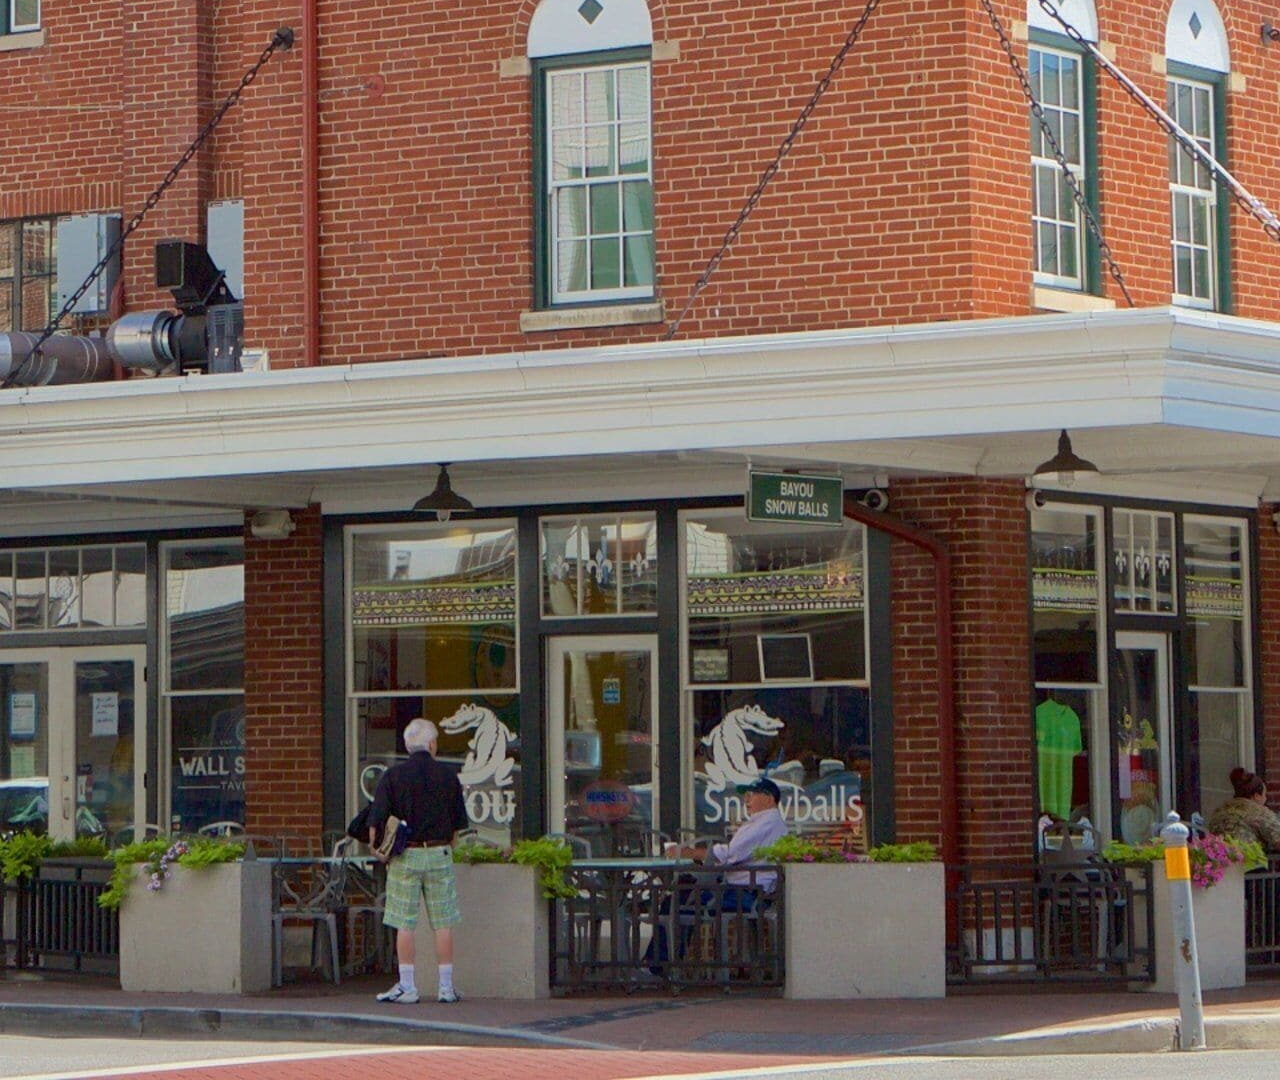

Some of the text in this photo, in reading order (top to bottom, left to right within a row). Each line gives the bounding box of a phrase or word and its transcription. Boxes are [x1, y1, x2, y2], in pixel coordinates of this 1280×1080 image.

[780, 481, 814, 498] BAYOU
[765, 498, 829, 517] SNOW BALLS
[179, 756, 230, 776] WALL
